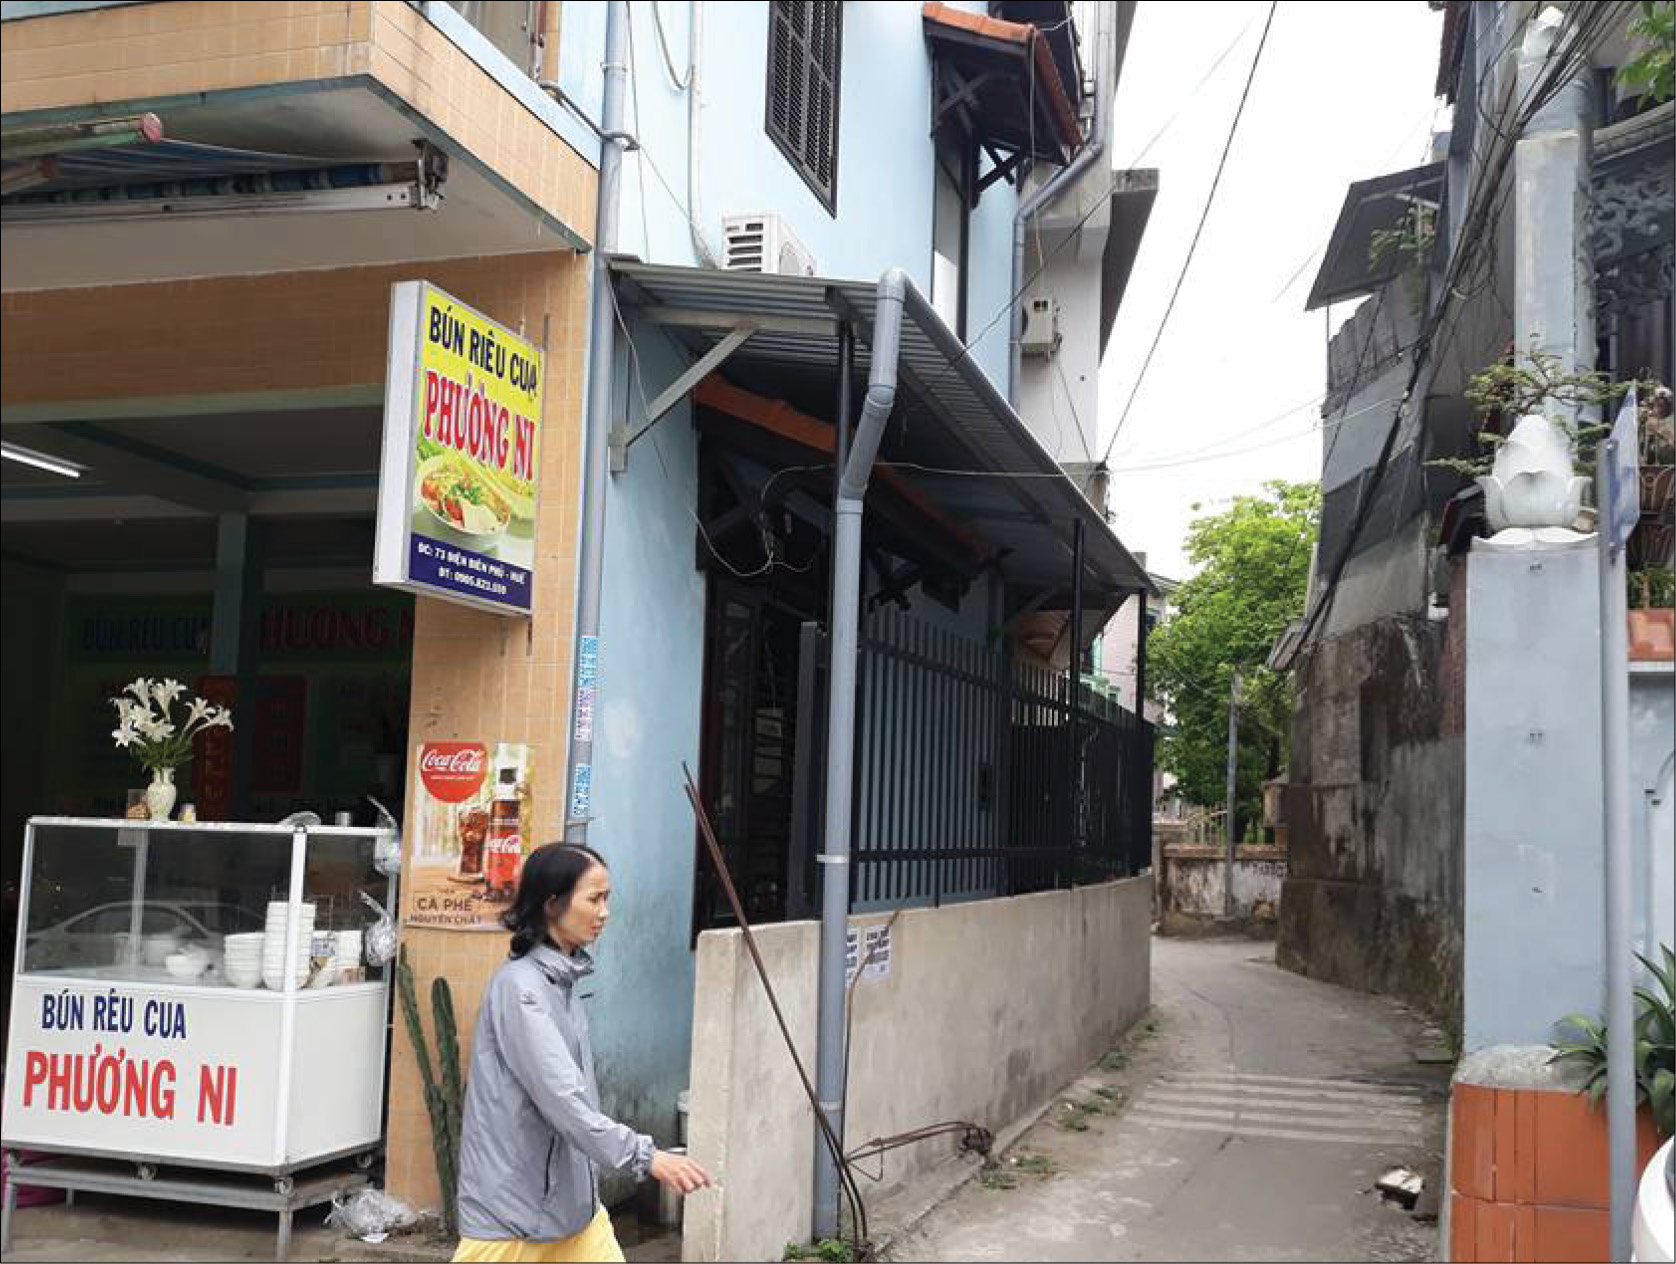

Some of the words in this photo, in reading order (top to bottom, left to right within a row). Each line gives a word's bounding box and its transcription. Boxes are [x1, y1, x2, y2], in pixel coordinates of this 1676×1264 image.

[429, 305, 465, 357] BÚN
[468, 330, 507, 379] RIÊU
[424, 370, 510, 470] PHƯƠNG
[513, 414, 535, 480] NI
[422, 749, 485, 772] Coca-Cola
[42, 988, 84, 1030] BÚN
[93, 988, 134, 1033] RÊU
[144, 1000, 187, 1039] CUA
[23, 1043, 177, 1121] PHƯƠNG
[197, 1063, 238, 1126] NI
